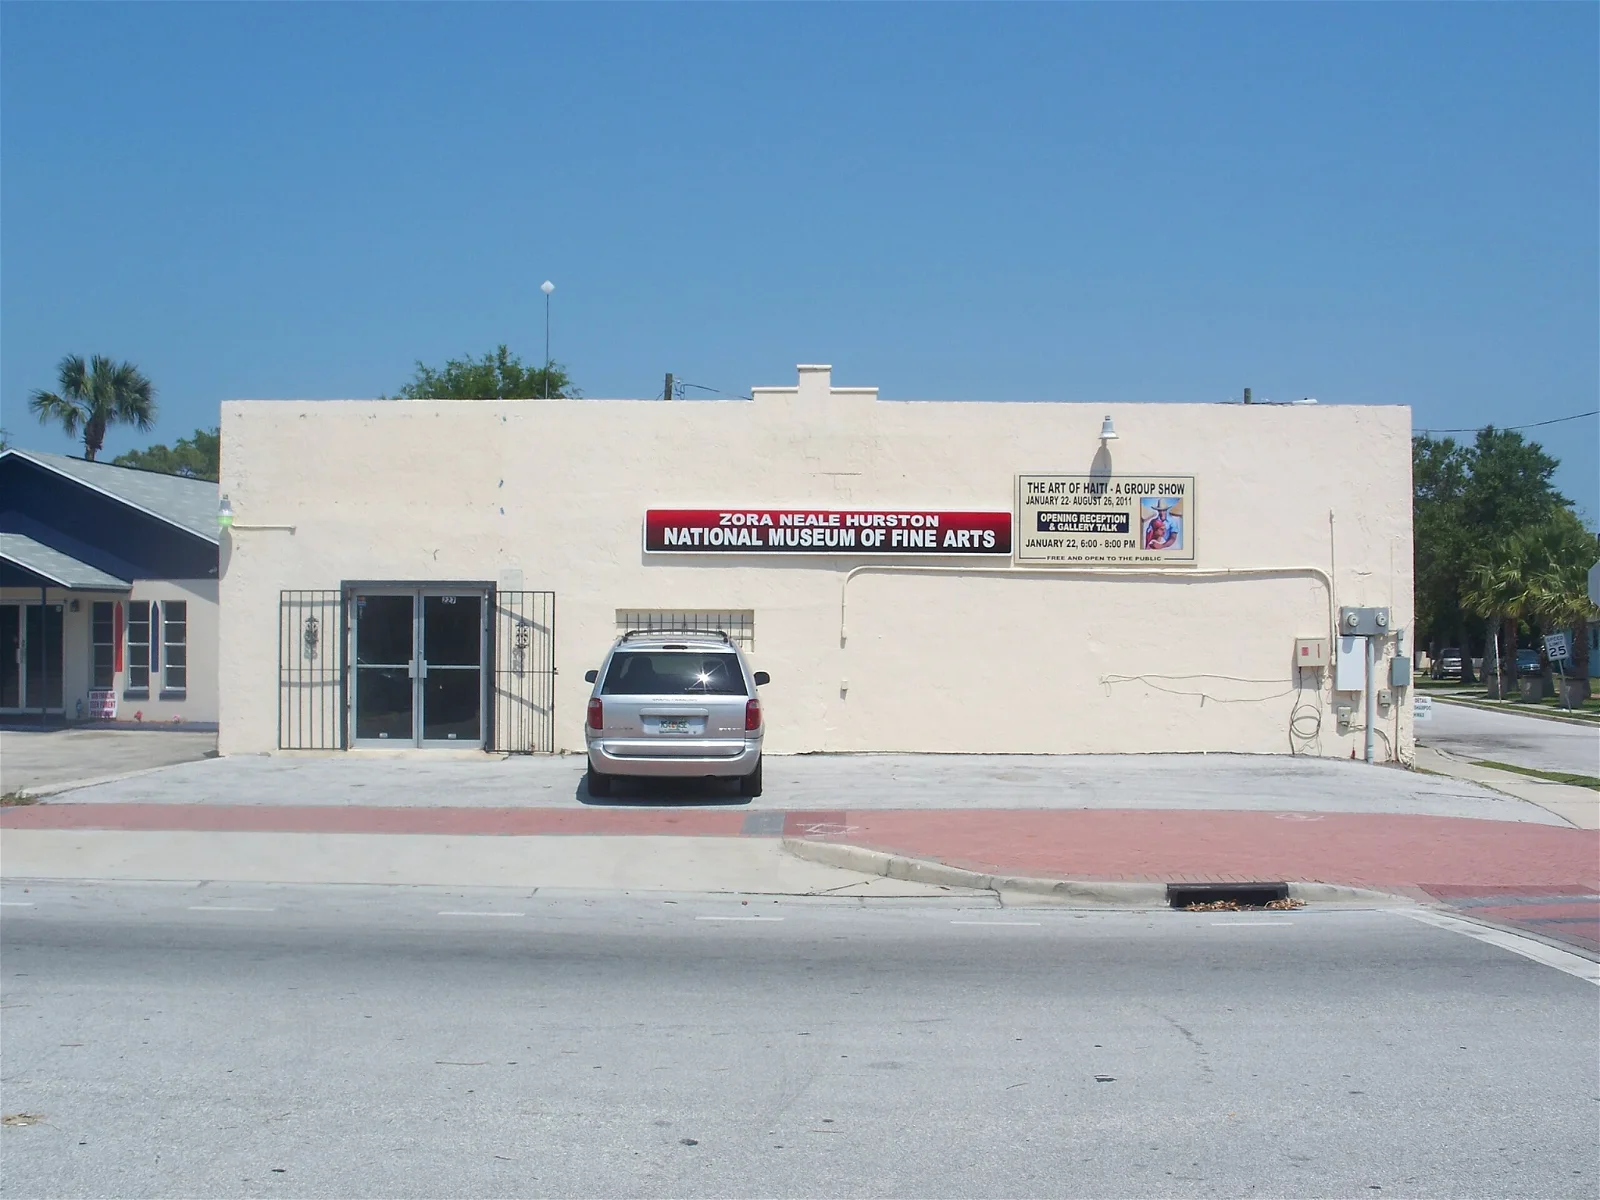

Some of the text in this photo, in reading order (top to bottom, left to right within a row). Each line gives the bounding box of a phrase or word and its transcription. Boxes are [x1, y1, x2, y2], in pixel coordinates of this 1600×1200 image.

[1028, 482, 1045, 493] THE
[1049, 483, 1065, 493] ART
[1069, 483, 1080, 493] OF
[1084, 483, 1107, 494] HAITI
[1116, 483, 1121, 494] A
[1125, 484, 1155, 495] GROUP
[1159, 484, 1185, 495] SHOW
[1026, 496, 1059, 505] JANUARY
[1073, 497, 1101, 506] AUGUST
[1104, 497, 1114, 508] 26,
[1116, 497, 1132, 506] 2011
[719, 513, 939, 527] ZORA NEALE HURSTON
[1040, 514, 1126, 523] OPENING RECEPTION
[1049, 523, 1055, 531] &
[1058, 523, 1094, 531] GALLERY
[664, 528, 995, 548] NATIONAL MUSEUM OF FINE ARTS
[1026, 539, 1063, 547] JANUARY
[1066, 540, 1078, 549] 22,
[1105, 540, 1121, 548] 8:00
[1124, 540, 1135, 548] PM
[1549, 646, 1566, 657] 25
